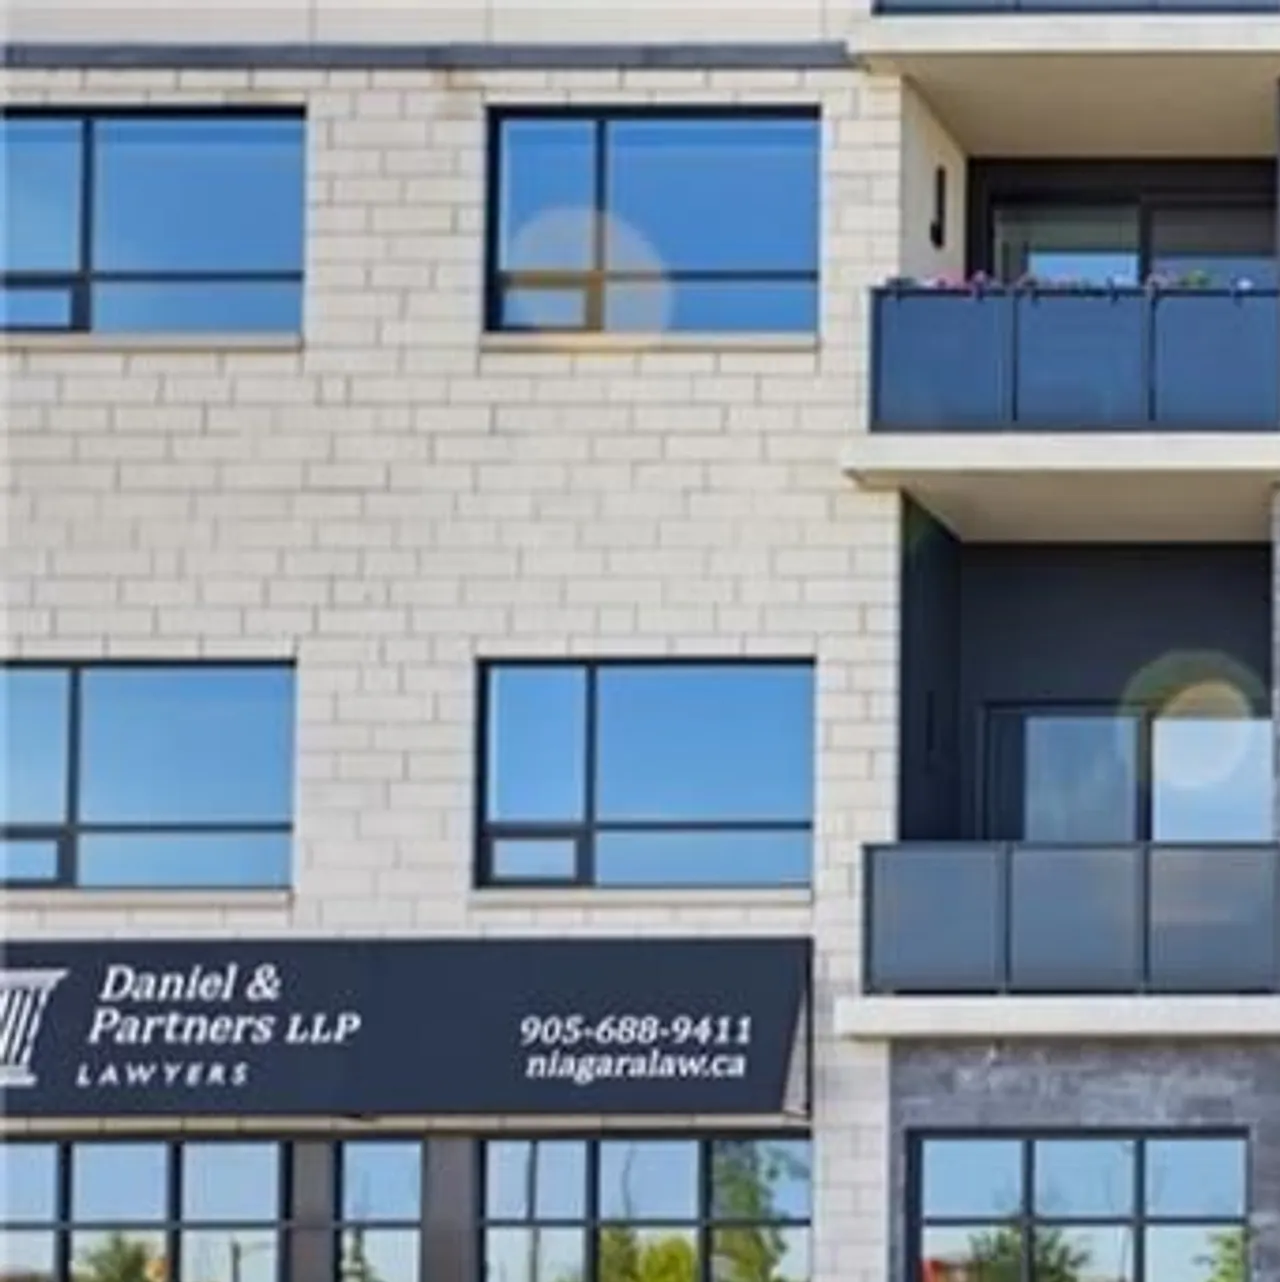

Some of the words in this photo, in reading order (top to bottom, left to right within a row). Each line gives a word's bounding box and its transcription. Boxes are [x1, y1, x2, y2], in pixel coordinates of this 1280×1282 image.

[98, 963, 238, 1002] Daniel
[245, 964, 282, 1001] &
[88, 1007, 277, 1047] Partners
[285, 1013, 363, 1045] LLP
[520, 1014, 752, 1046] 905-688-9411
[76, 1062, 249, 1087] LAWYERS
[524, 1048, 747, 1086] niagaralaw.ca
